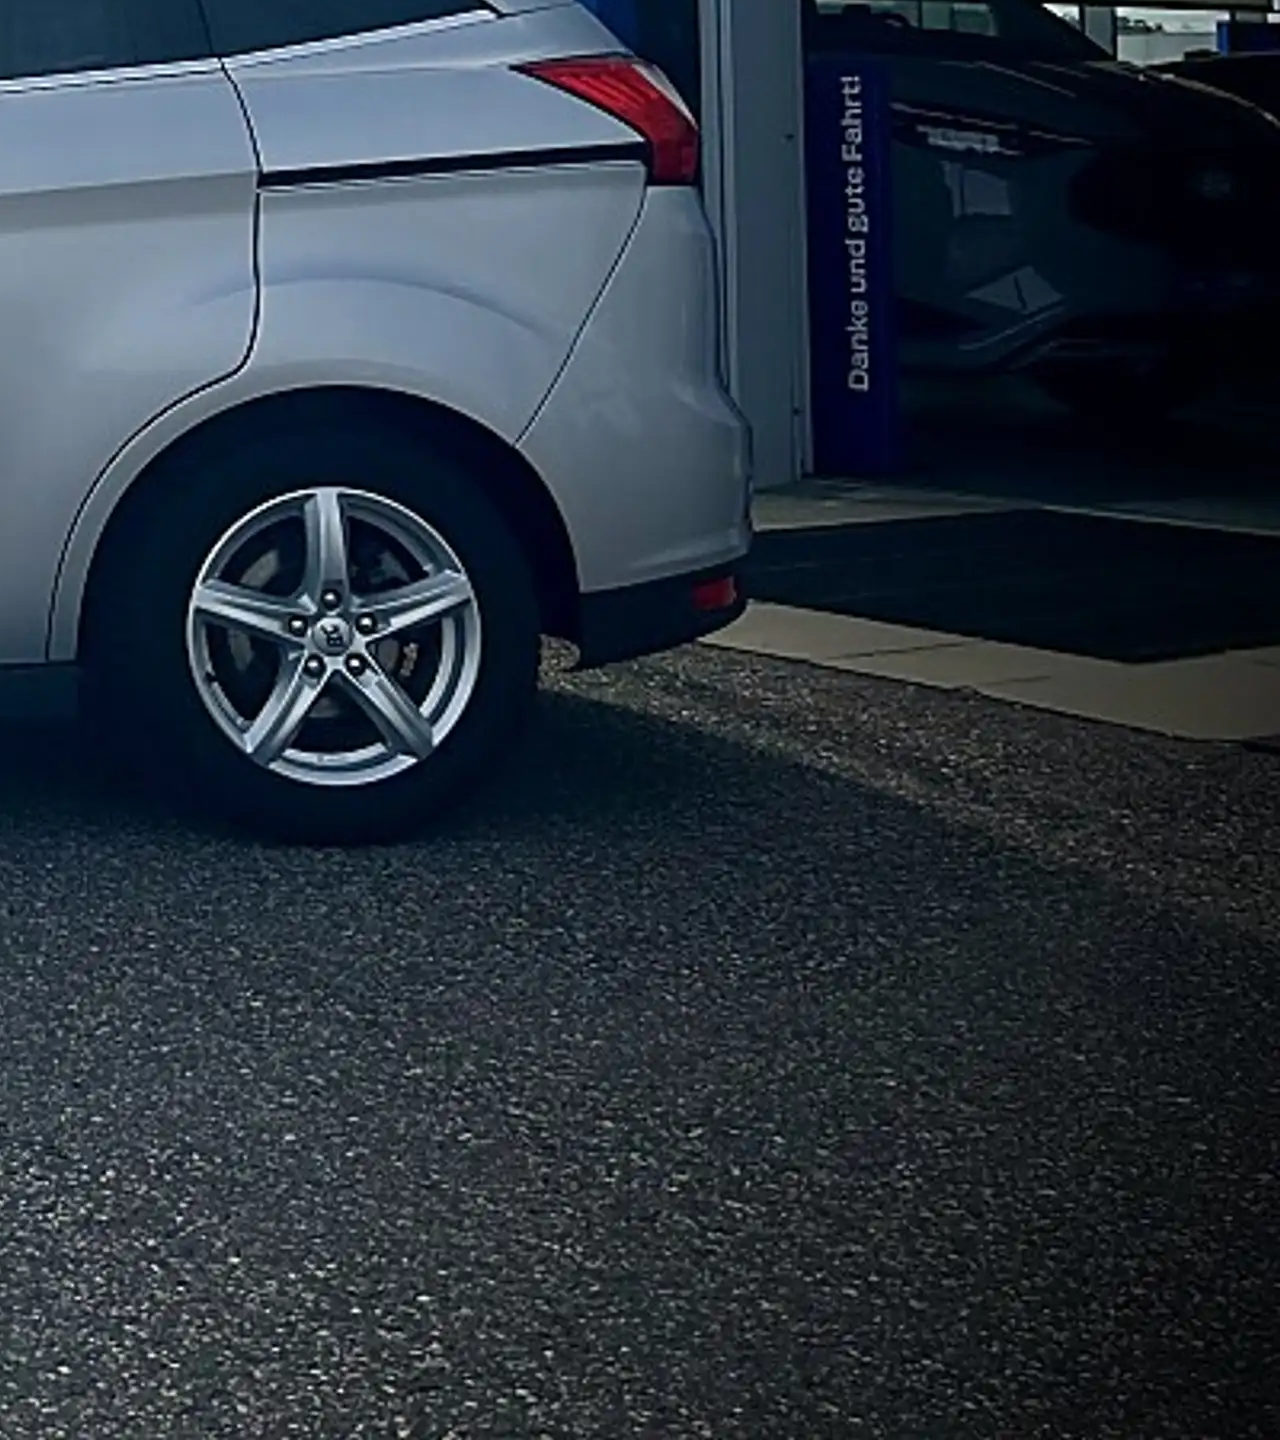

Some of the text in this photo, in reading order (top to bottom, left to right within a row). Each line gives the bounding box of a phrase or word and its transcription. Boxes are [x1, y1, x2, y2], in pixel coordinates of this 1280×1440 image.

[840, 76, 869, 392] Danke und gute Fahrt!
